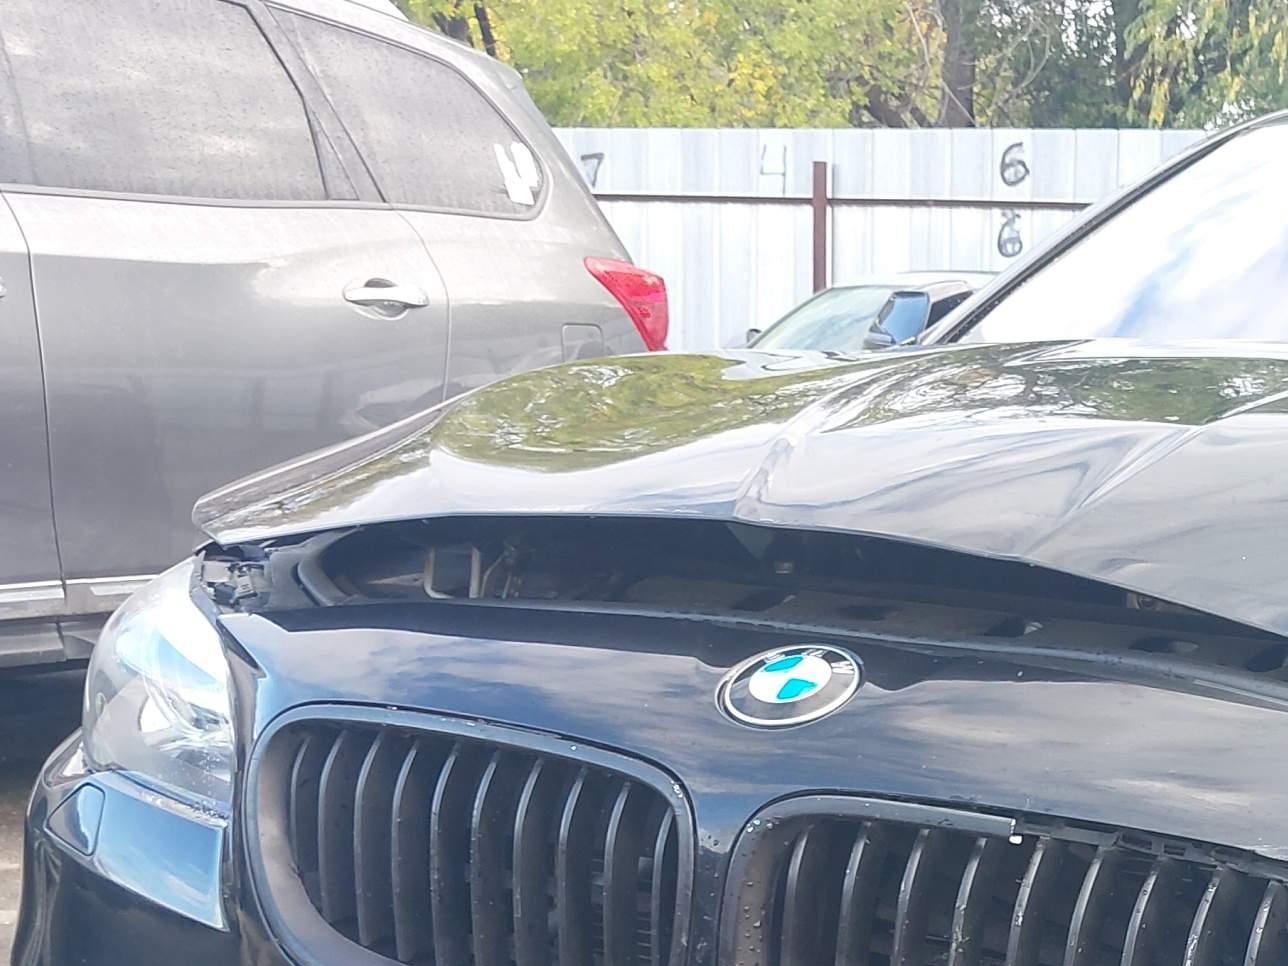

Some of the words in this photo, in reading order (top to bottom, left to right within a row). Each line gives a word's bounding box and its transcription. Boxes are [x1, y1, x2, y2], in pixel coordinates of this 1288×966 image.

[580, 152, 605, 188] 7
[760, 144, 787, 196] 4
[1000, 141, 1030, 187] 6
